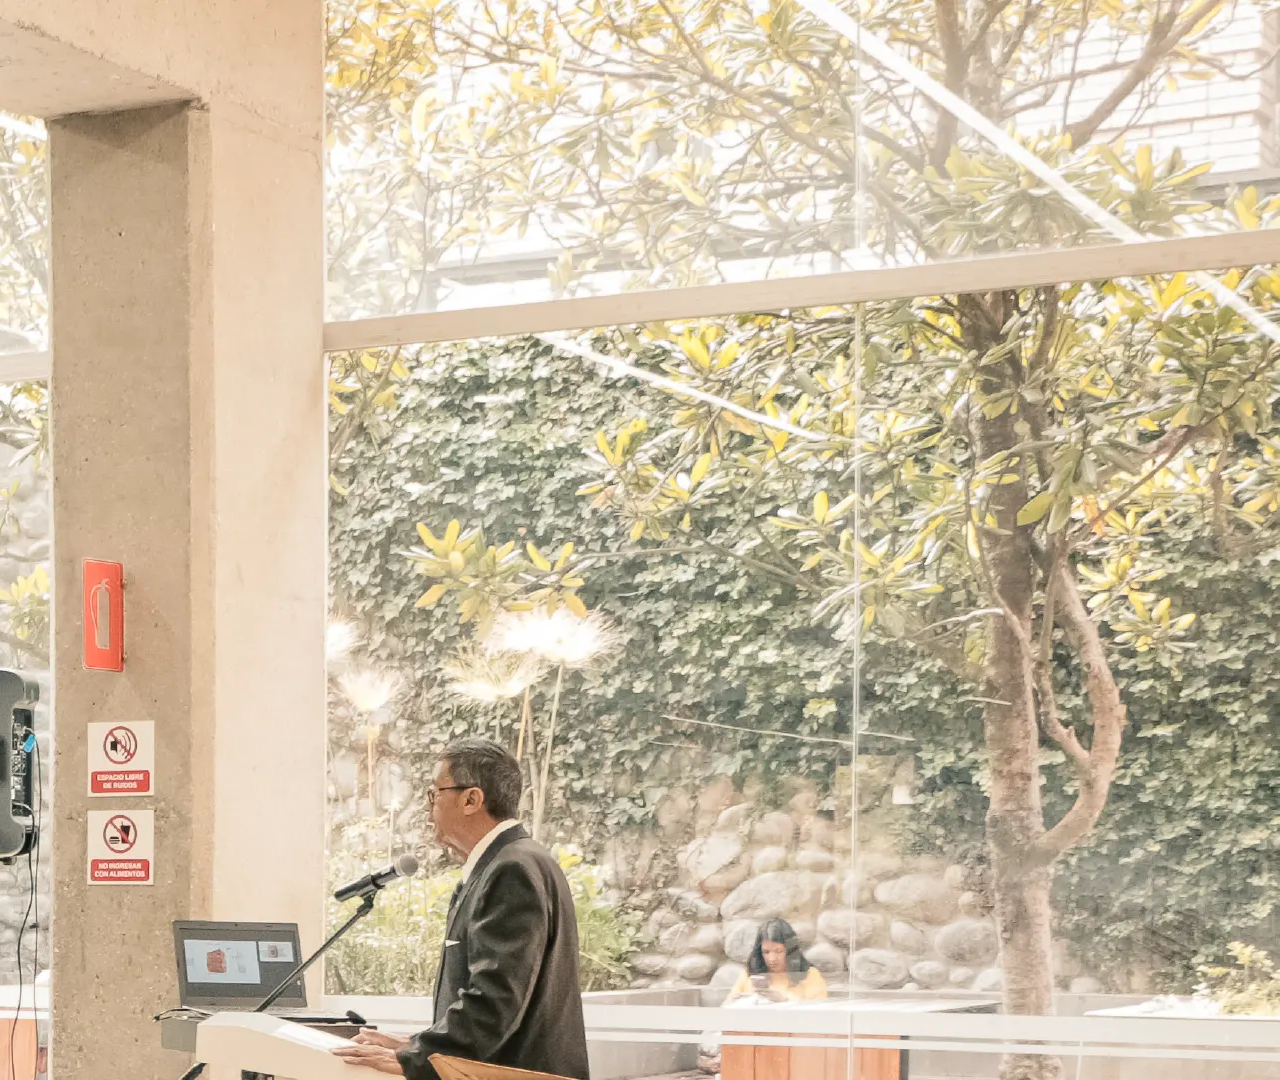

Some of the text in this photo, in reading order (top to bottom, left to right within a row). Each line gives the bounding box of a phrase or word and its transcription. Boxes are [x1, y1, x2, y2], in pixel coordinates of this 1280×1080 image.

[96, 773, 144, 782] ESPACIO LIBRE
[94, 870, 146, 878] CON ALIMENTOS
